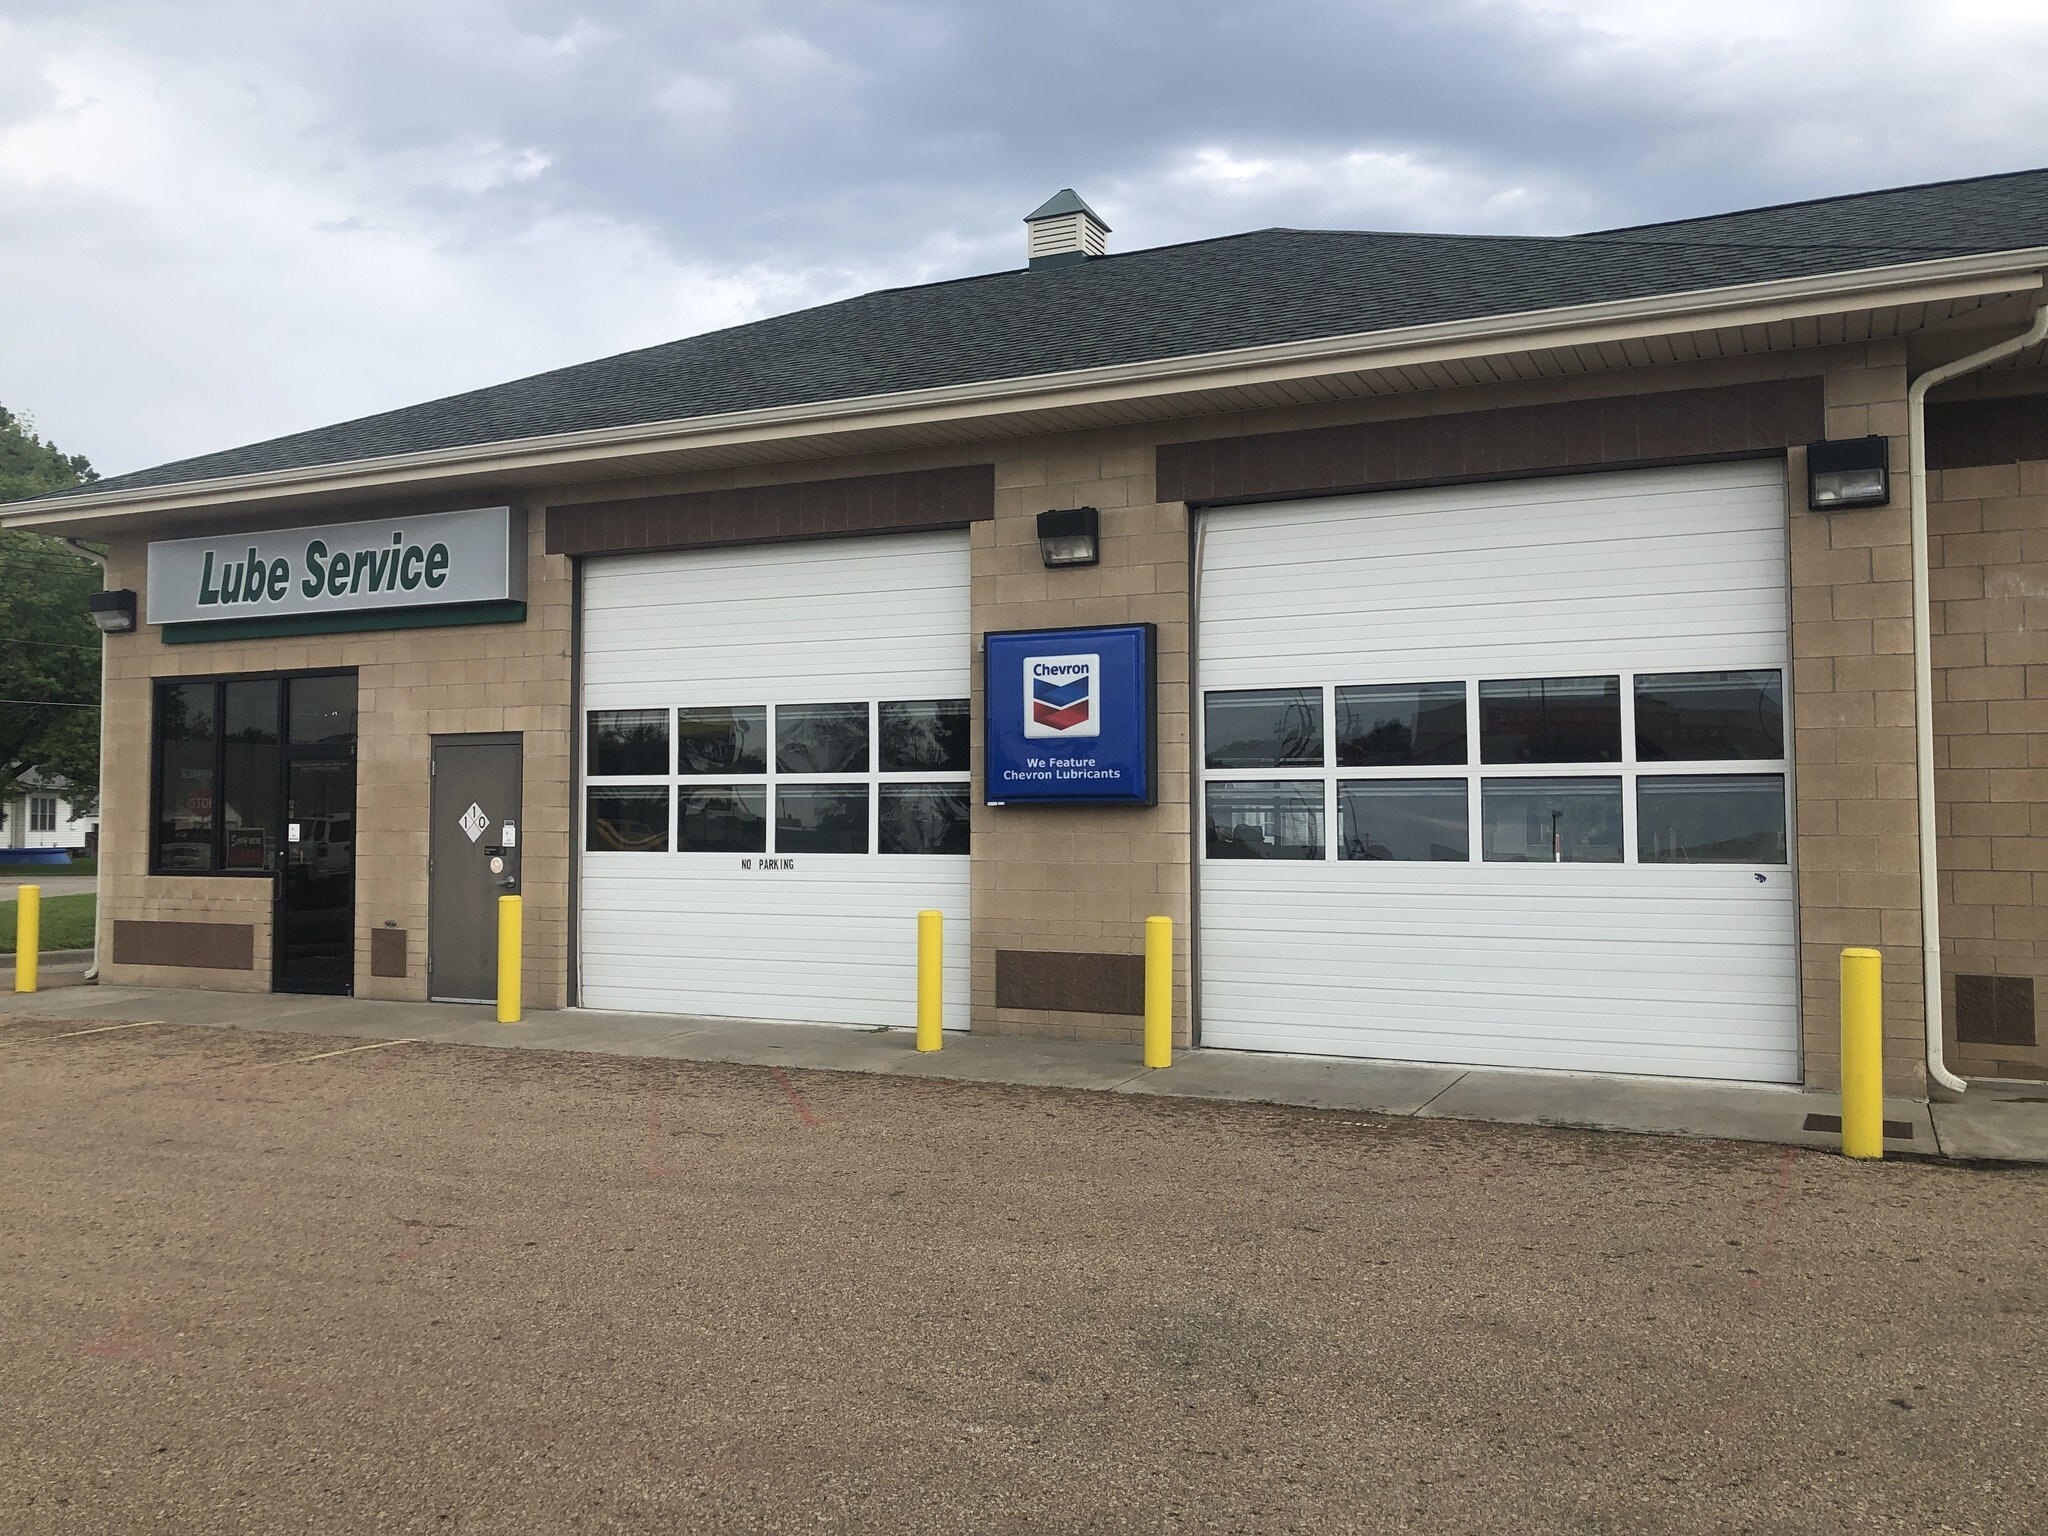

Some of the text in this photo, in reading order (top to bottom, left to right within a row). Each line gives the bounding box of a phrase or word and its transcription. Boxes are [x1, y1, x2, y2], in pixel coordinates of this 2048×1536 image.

[198, 532, 450, 605] Lube Service
[1033, 663, 1089, 676] Chevron
[1027, 757, 1095, 768] We Feature
[1003, 769, 1120, 780] Chevron Lubricants
[478, 816, 486, 828] 0
[741, 859, 794, 869] NO PARKING
